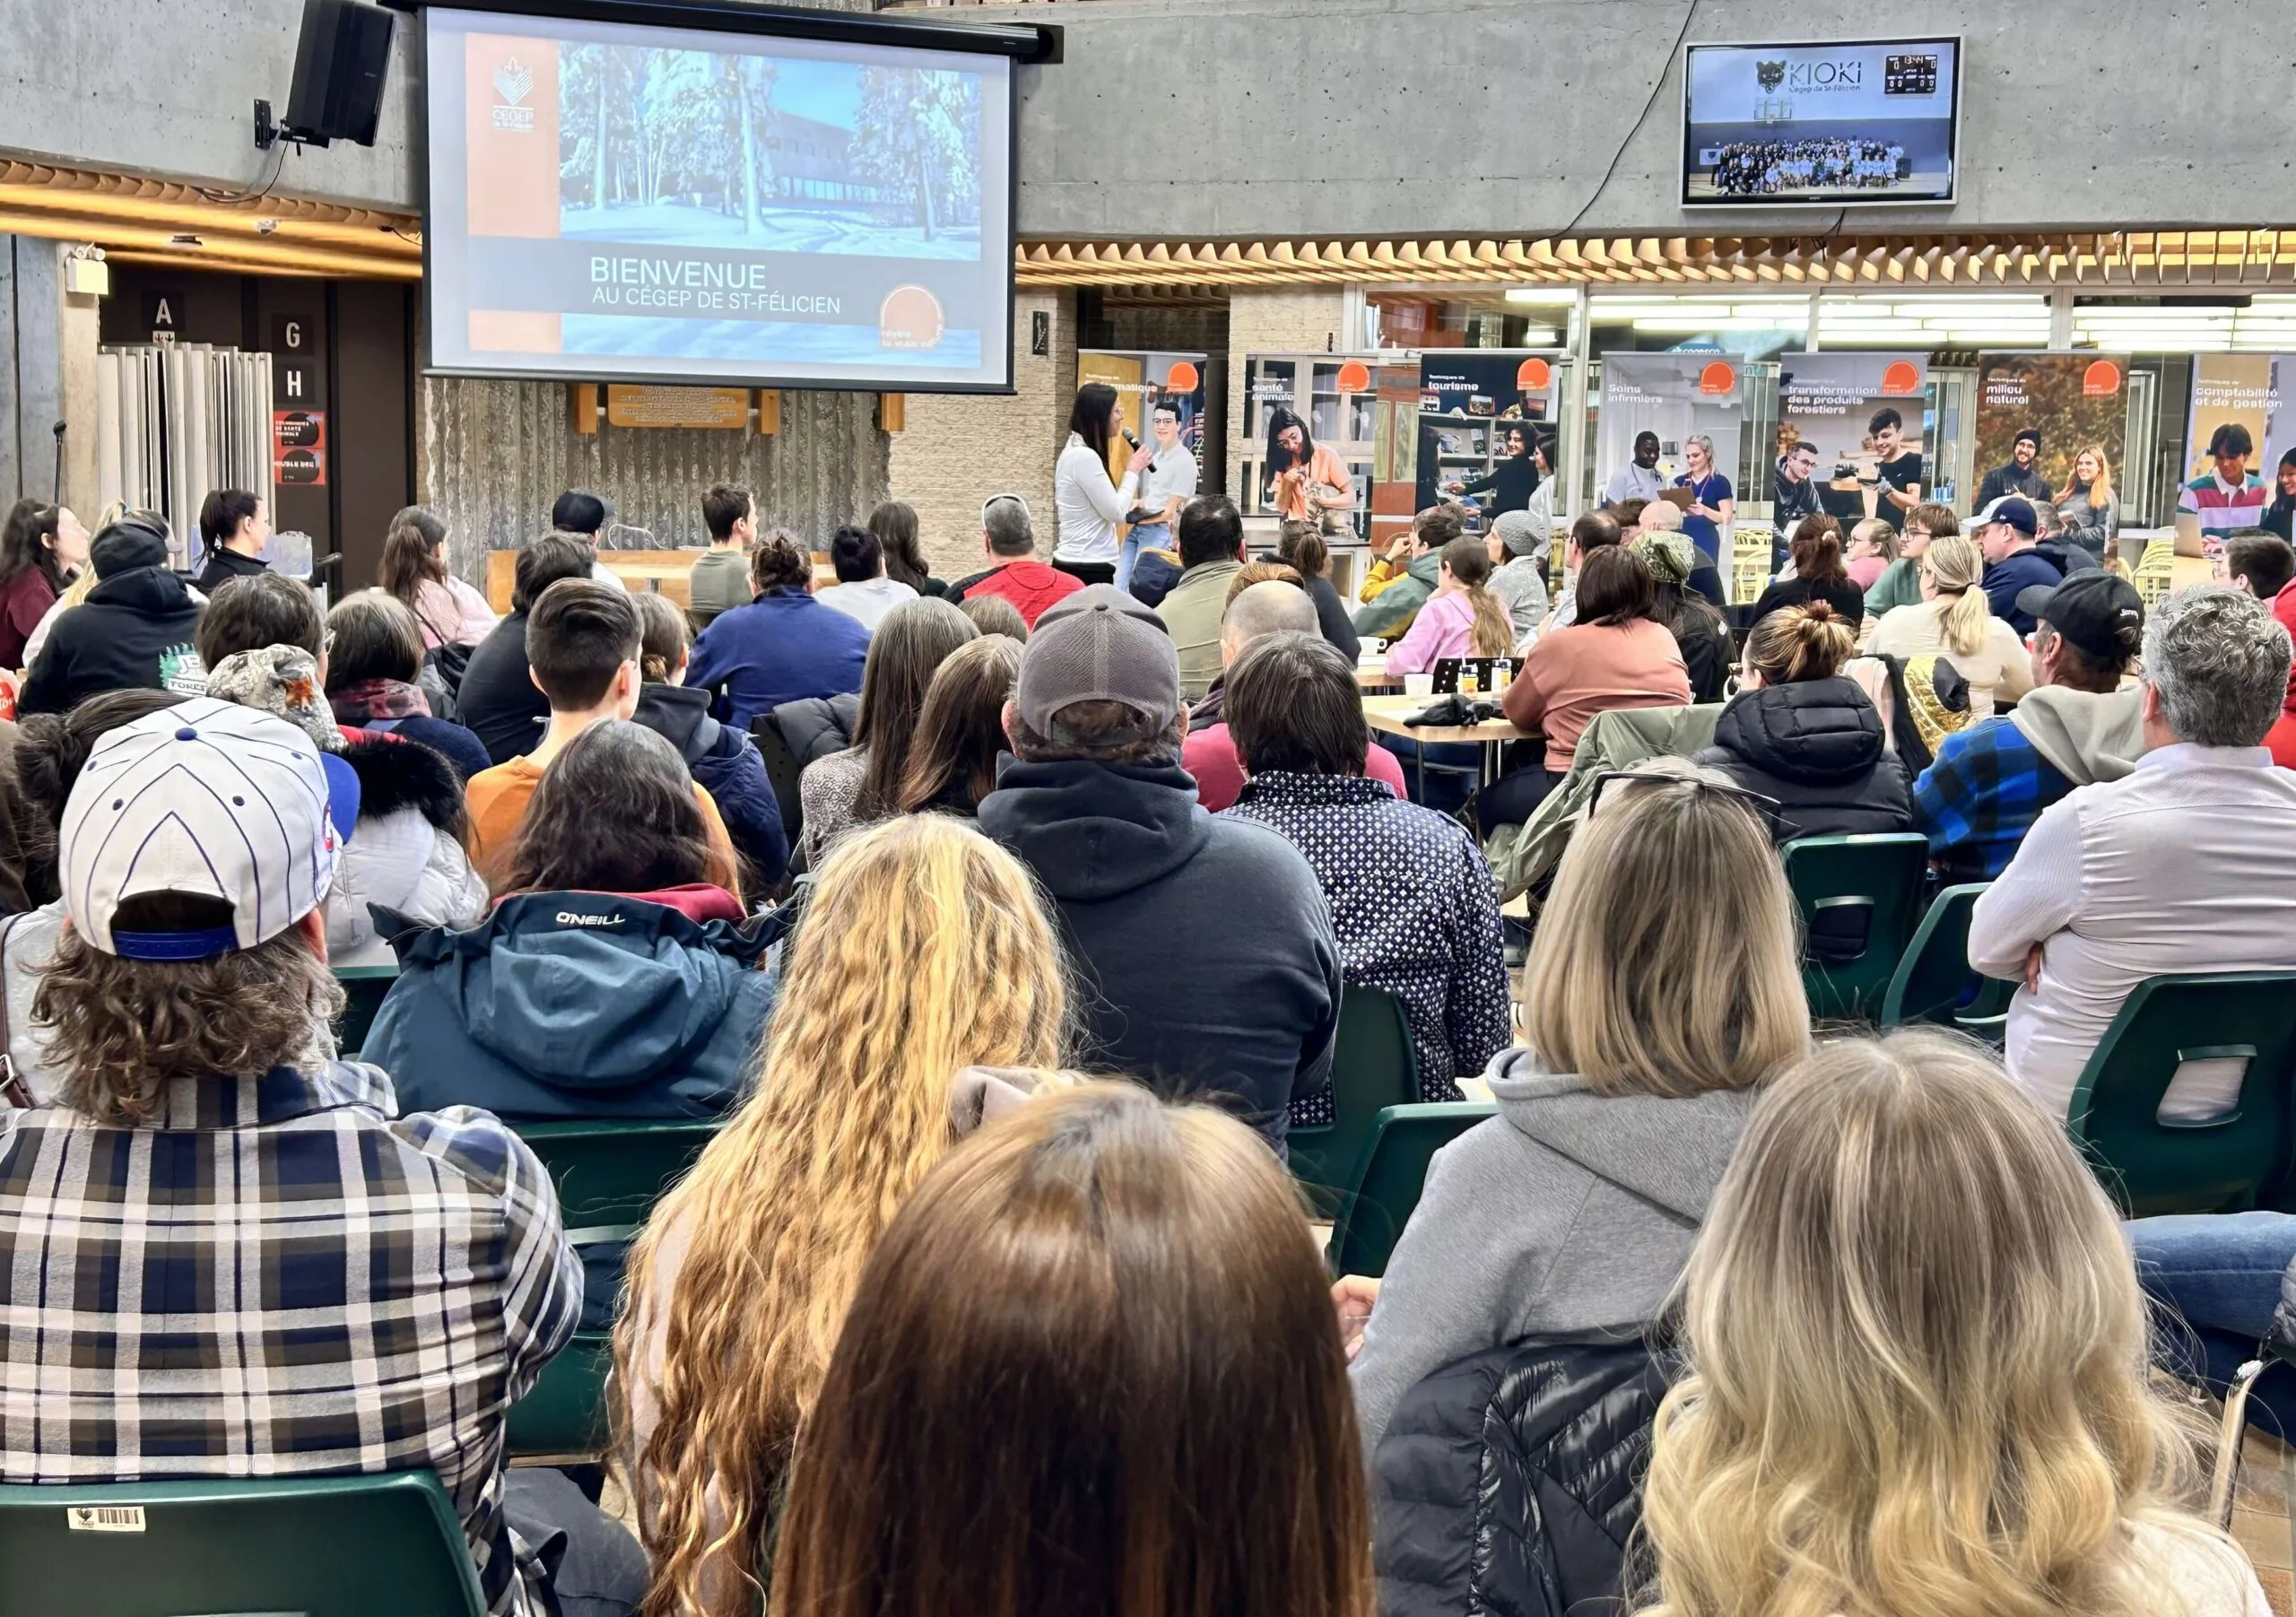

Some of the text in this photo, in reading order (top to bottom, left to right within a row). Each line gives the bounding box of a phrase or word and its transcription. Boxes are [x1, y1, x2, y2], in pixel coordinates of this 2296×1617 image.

[1790, 61, 1861, 85] KIOKI
[590, 256, 766, 290] BIENVENUE
[592, 284, 840, 314] AU CÉGEP DE ST-FÉLICIEN
[155, 298, 173, 325] A
[285, 322, 300, 348] G
[287, 370, 301, 396] H
[1251, 383, 1283, 393] santé
[1428, 381, 1479, 391] tourisme
[1608, 384, 1641, 394] Soins
[1788, 385, 1878, 395] transformation
[1986, 384, 2022, 395] milieu
[2196, 387, 2279, 399] comptabilité
[1251, 392, 1294, 402] animale
[1608, 394, 1663, 404] infirmiers
[1787, 395, 1865, 405] des produits
[1986, 395, 2030, 405] naturel
[2195, 397, 2283, 410] et de gestion
[1787, 404, 1847, 414] forestiers
